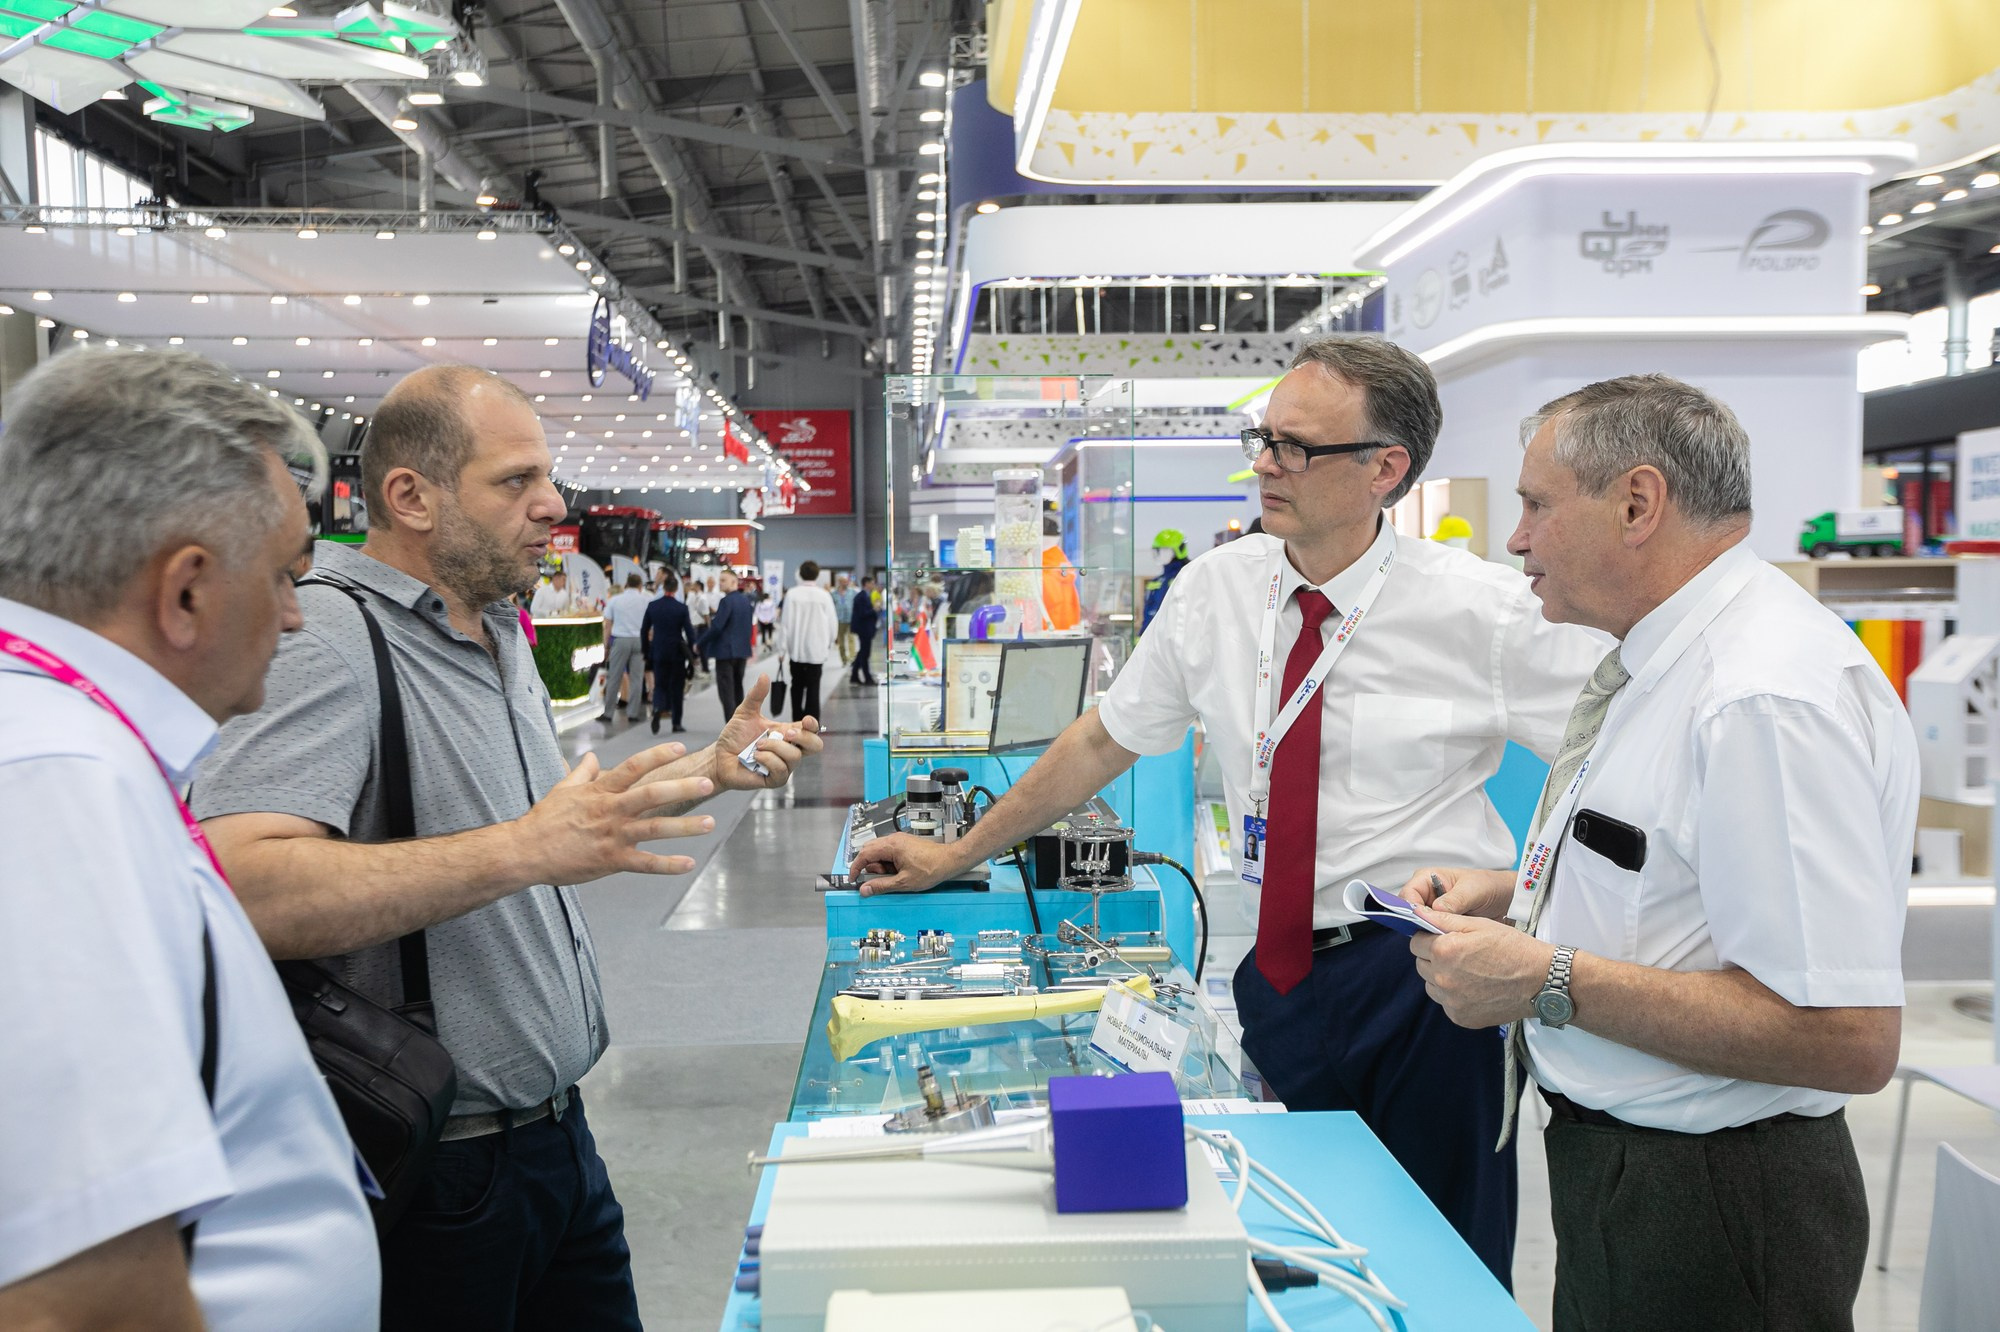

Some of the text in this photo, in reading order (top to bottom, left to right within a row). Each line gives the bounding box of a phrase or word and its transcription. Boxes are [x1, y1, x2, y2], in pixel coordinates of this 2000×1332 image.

[1341, 606, 1359, 632] MADE IN
[1345, 609, 1364, 635] BELARUS
[1264, 741, 1276, 762] BELARUS
[1265, 737, 1271, 745] IN
[1526, 852, 1541, 878] MADE
[1537, 843, 1545, 853] IN
[1533, 847, 1552, 880] BELARUS
[1106, 1014, 1123, 1030] НОВЫЕ
[1122, 1024, 1173, 1061] ФУНКЦИОНАЛЬНЫЕ
[1117, 1034, 1150, 1061] МАТЕРИАЛЫ
